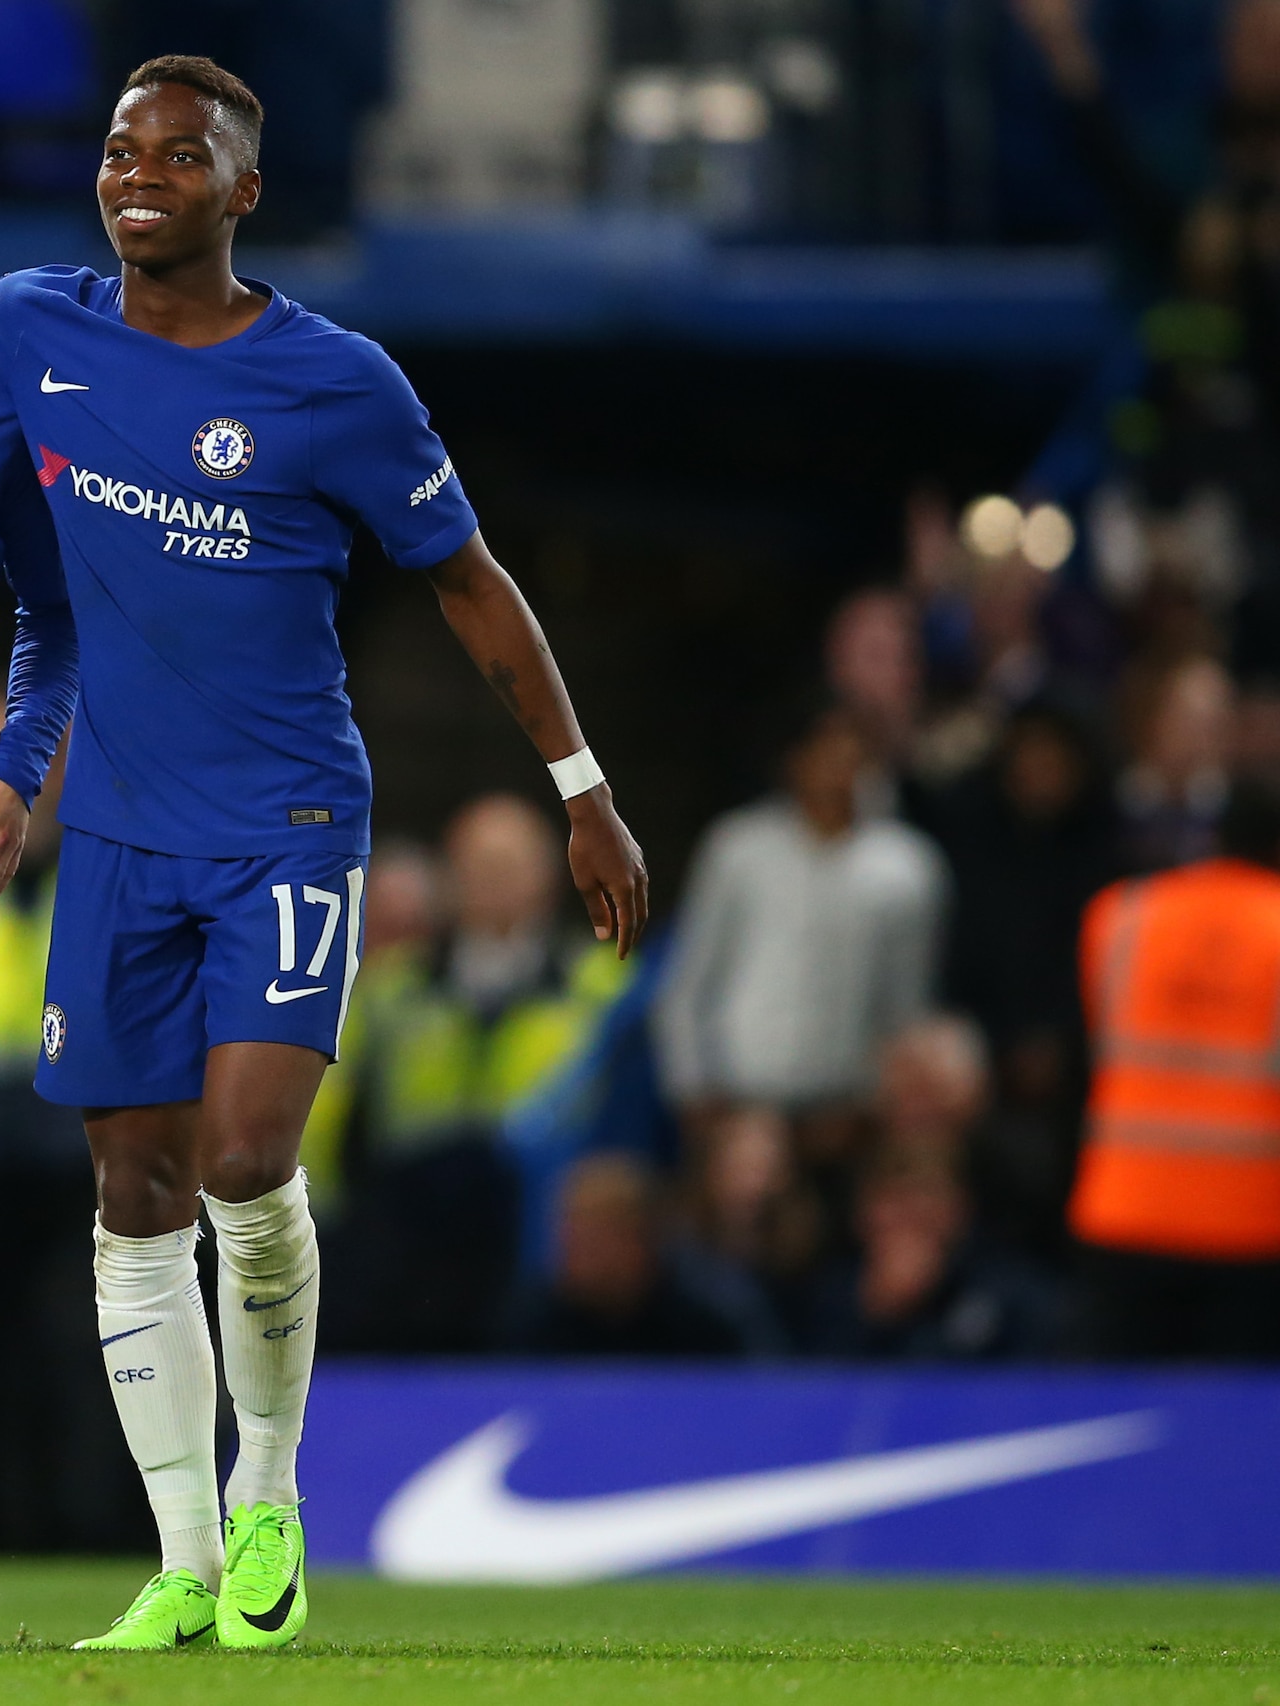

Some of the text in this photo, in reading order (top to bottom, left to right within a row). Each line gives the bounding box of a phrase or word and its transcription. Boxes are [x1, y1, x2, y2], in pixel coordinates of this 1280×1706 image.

[209, 420, 248, 440] CHELSEA
[69, 465, 251, 536] YOKOHAMA
[163, 530, 251, 560] TYRES
[271, 883, 341, 977] 17
[263, 1317, 304, 1339] CFC
[114, 1367, 155, 1383] CFC
